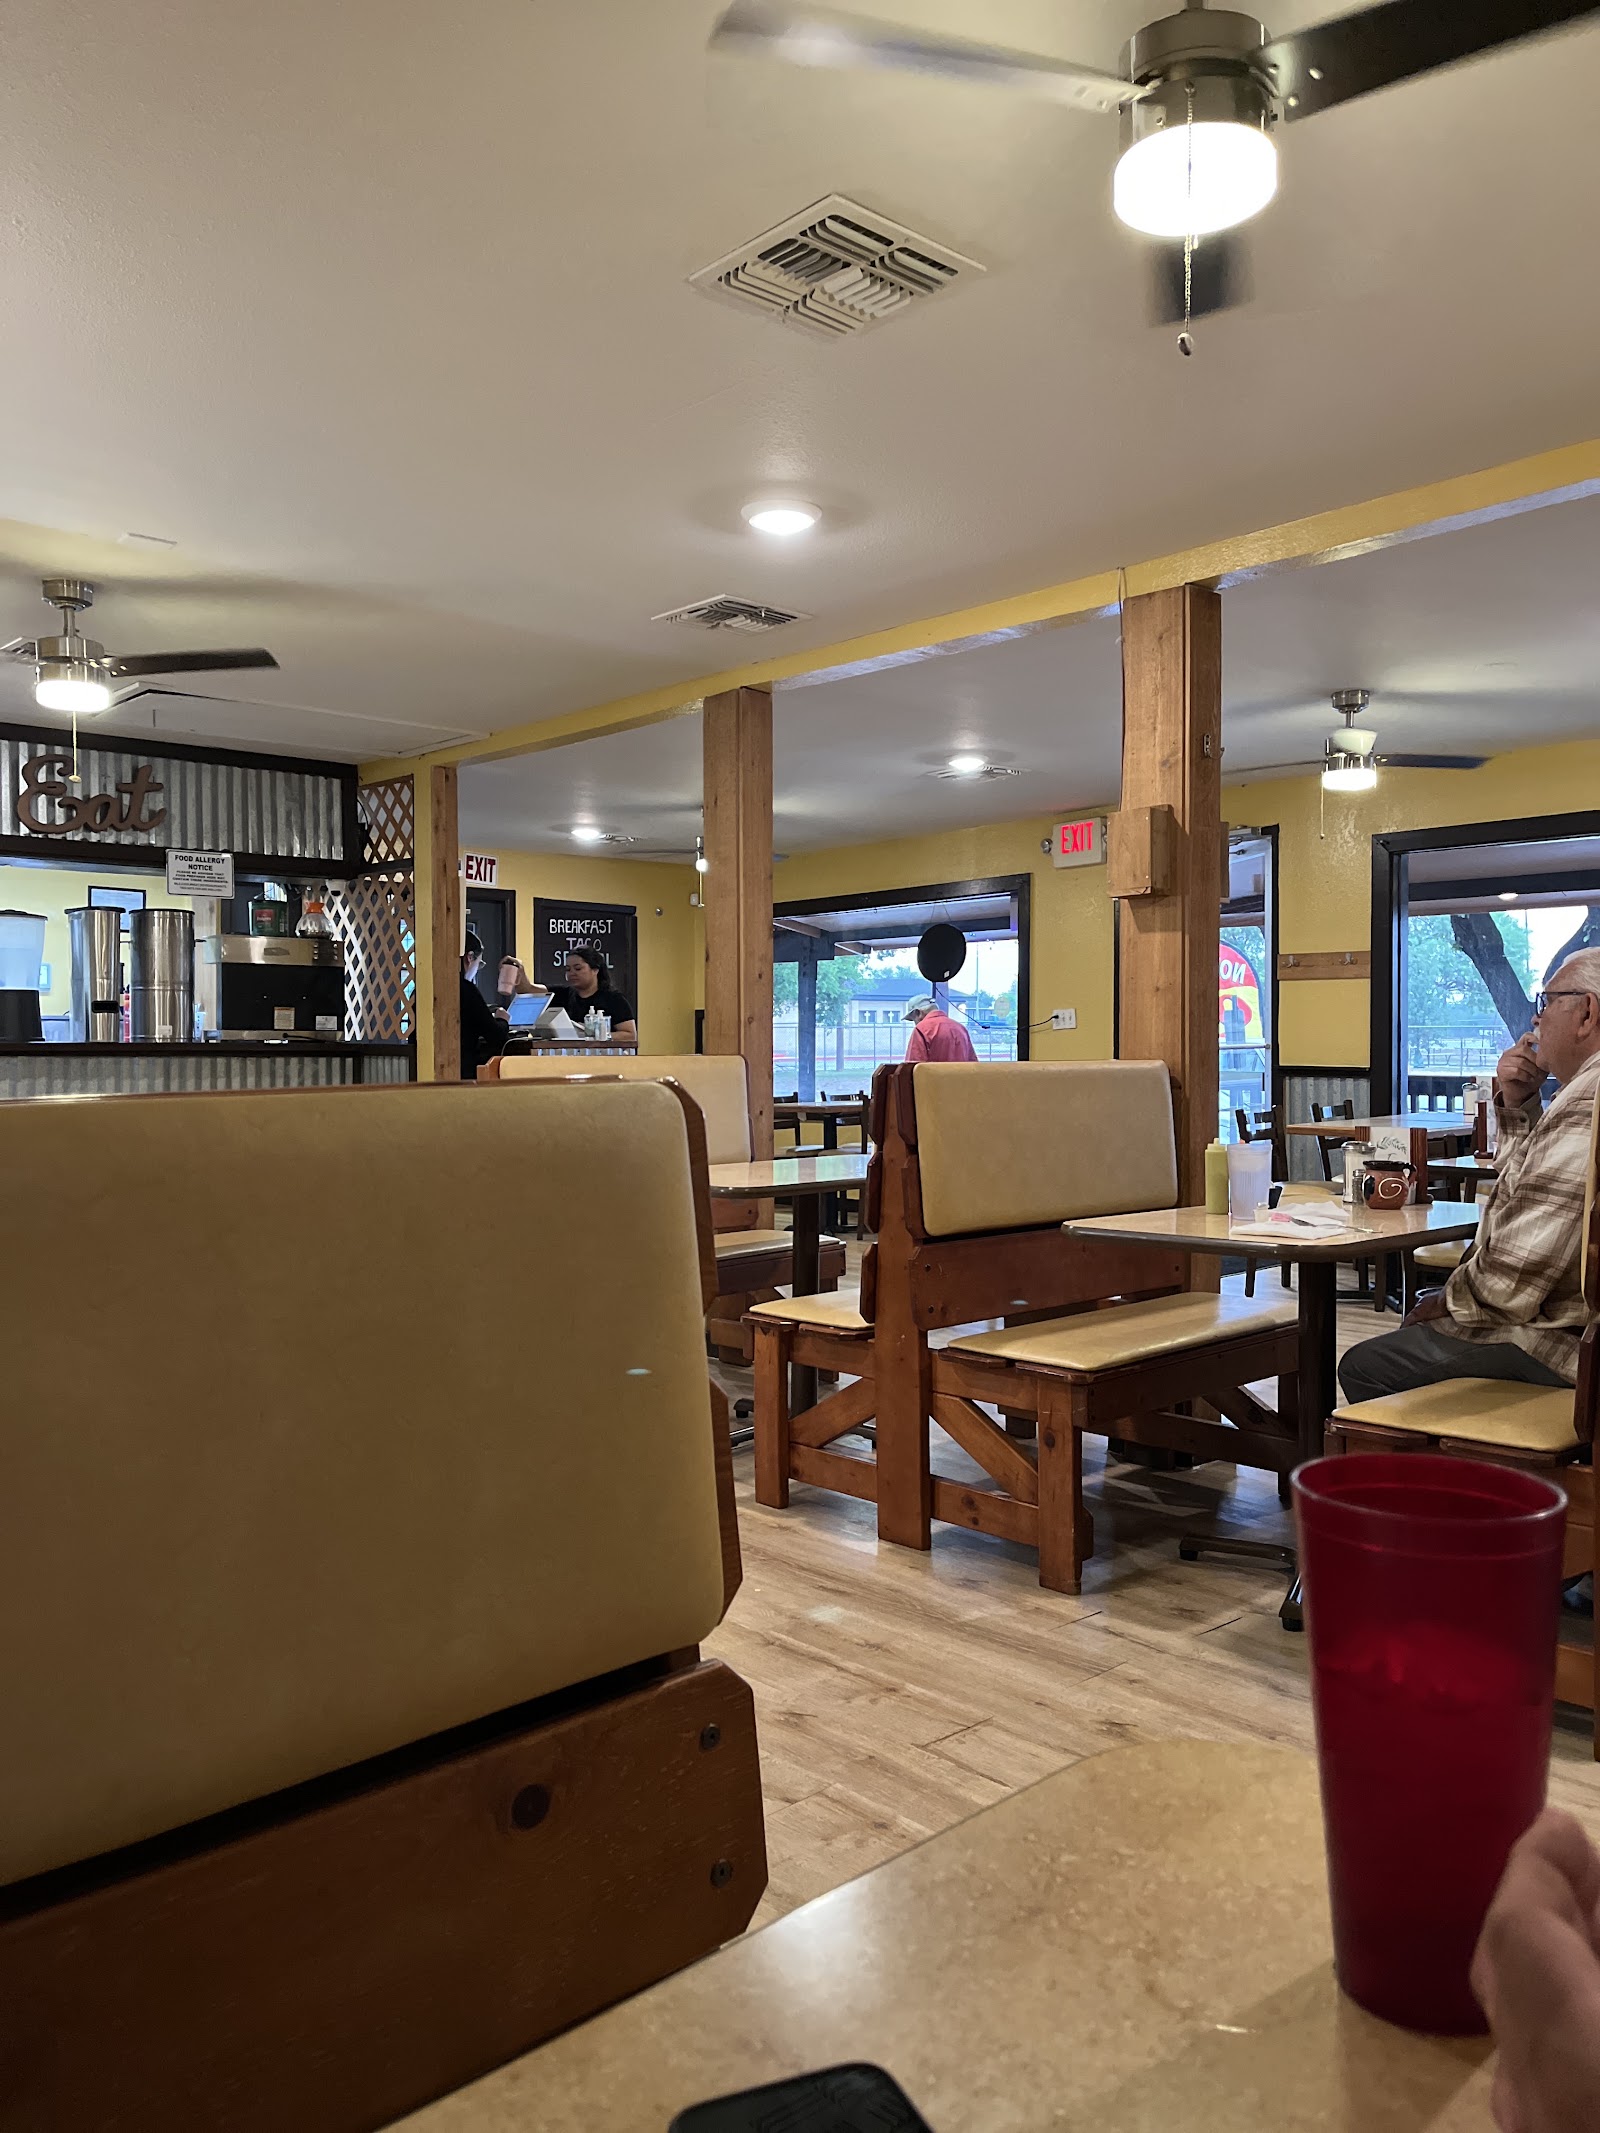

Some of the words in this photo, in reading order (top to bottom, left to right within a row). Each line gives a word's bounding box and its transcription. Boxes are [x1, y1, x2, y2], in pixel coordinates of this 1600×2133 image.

[17, 753, 168, 834] Eat
[1061, 821, 1094, 854] EXIT
[195, 856, 226, 864] ALLERGY
[466, 854, 496, 883] EXIT
[549, 918, 614, 934] BREAKFAST
[566, 937, 602, 951] TACO
